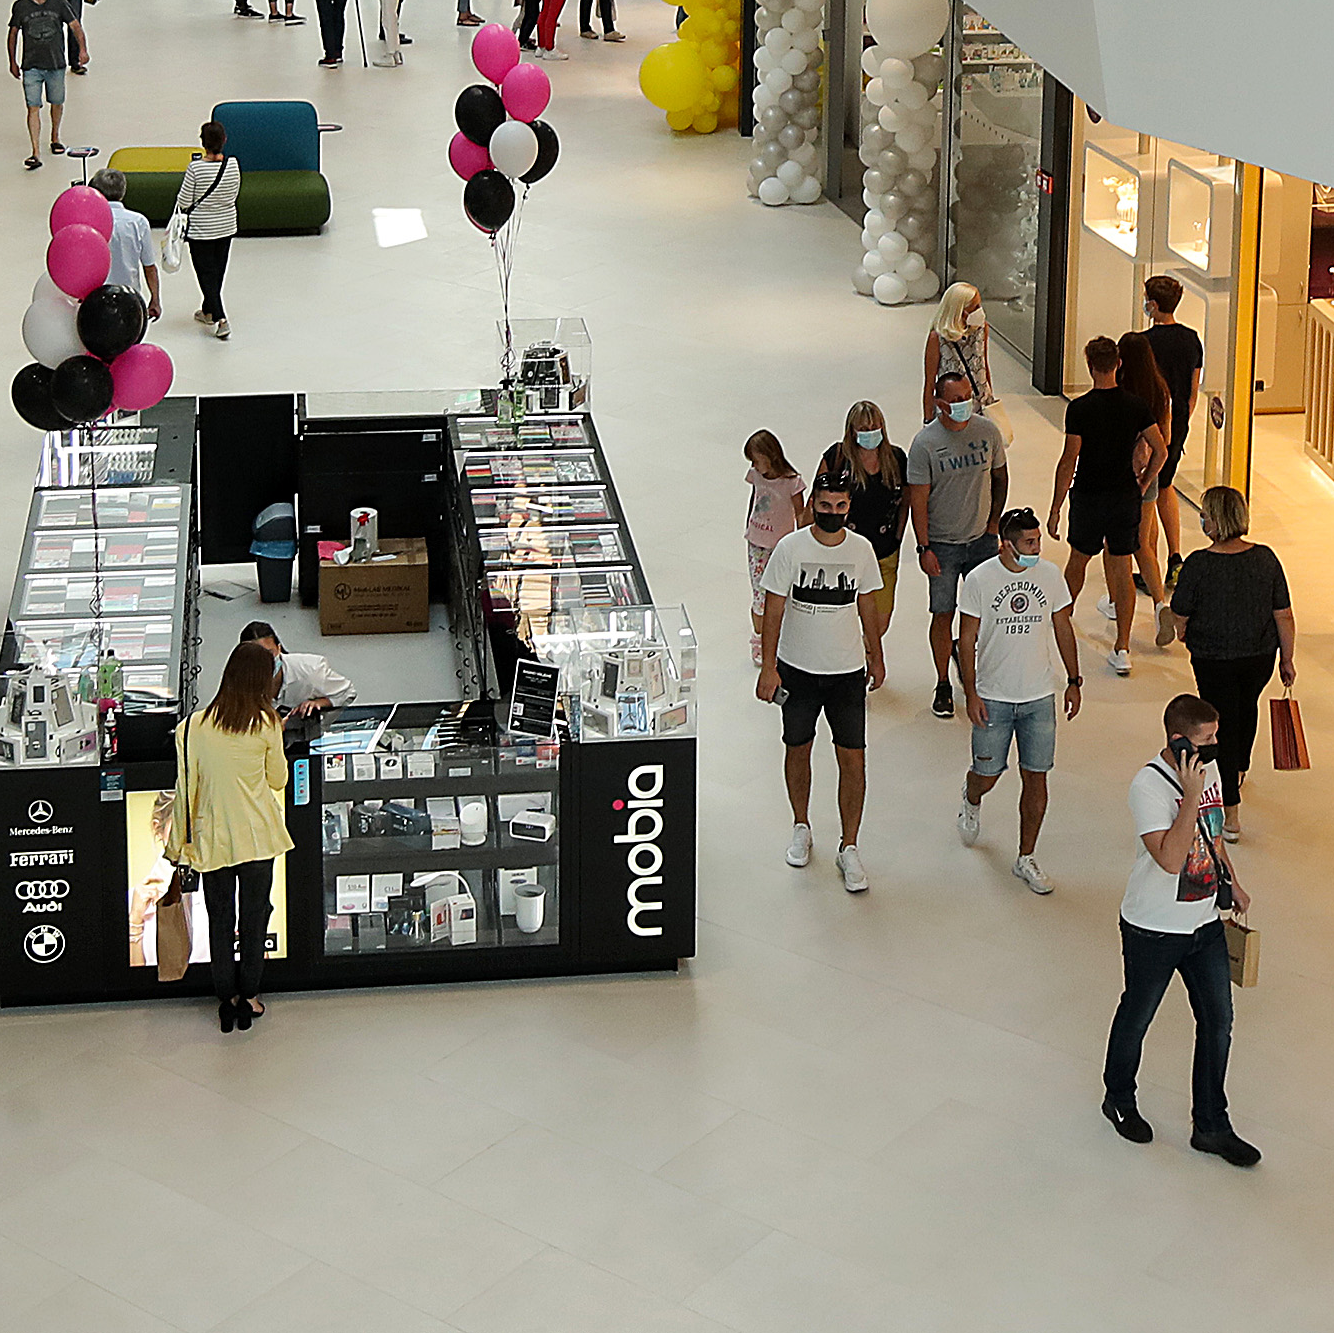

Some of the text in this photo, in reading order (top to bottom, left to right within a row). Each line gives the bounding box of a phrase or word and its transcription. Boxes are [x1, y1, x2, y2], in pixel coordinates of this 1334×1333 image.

[940, 451, 987, 473] I WILL
[991, 581, 1047, 612] ABERCROMBIE
[996, 615, 1042, 625] ESTABLISHED
[1006, 624, 1030, 635] 1892
[10, 826, 73, 836] Mercedes-Benz
[612, 764, 664, 936] mobia
[10, 850, 74, 867] Ferrari
[22, 901, 62, 913] Audi
